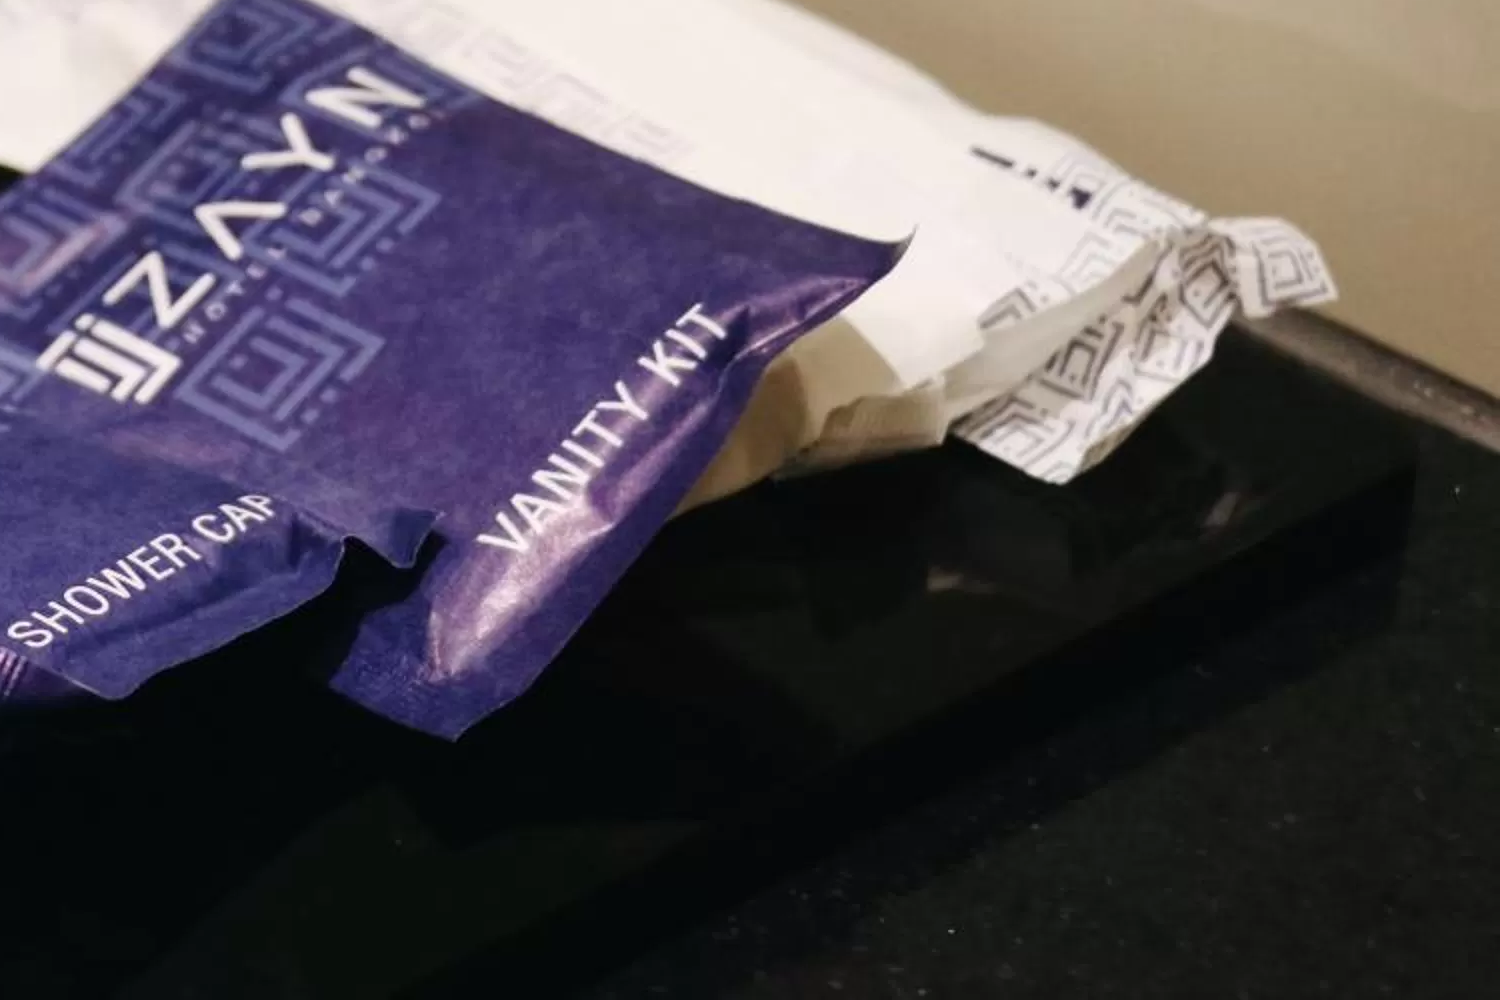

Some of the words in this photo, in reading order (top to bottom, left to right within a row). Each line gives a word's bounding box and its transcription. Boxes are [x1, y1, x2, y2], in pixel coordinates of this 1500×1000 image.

[183, 246, 287, 344] HOTEL
[475, 379, 648, 554] VANITY
[637, 302, 726, 387] KIT
[7, 533, 202, 649] SHOWER
[191, 493, 275, 544] CAP
